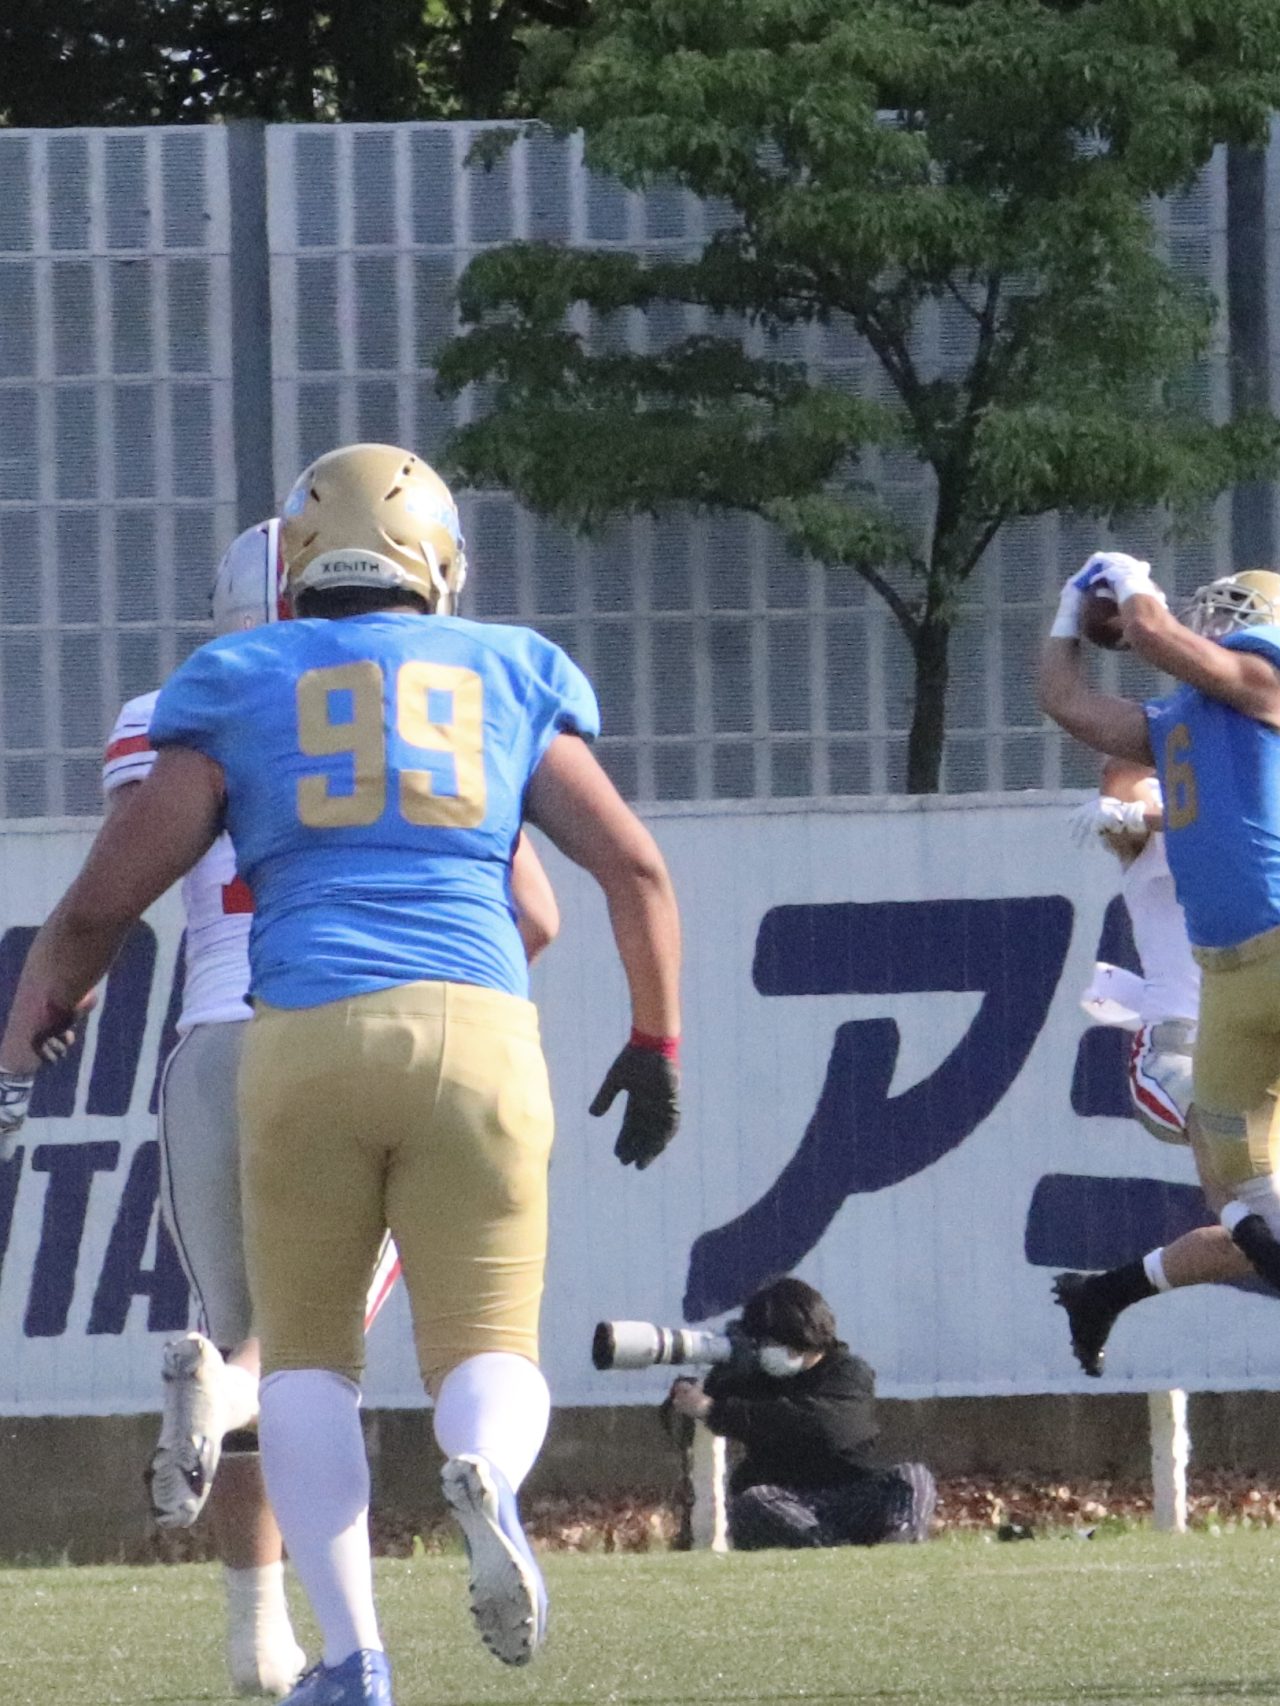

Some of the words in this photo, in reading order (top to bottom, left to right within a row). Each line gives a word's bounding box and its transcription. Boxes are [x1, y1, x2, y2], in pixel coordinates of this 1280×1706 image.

[322, 561, 380, 574] XENITH
[295, 660, 487, 829] 99
[1164, 723, 1197, 831] 6
